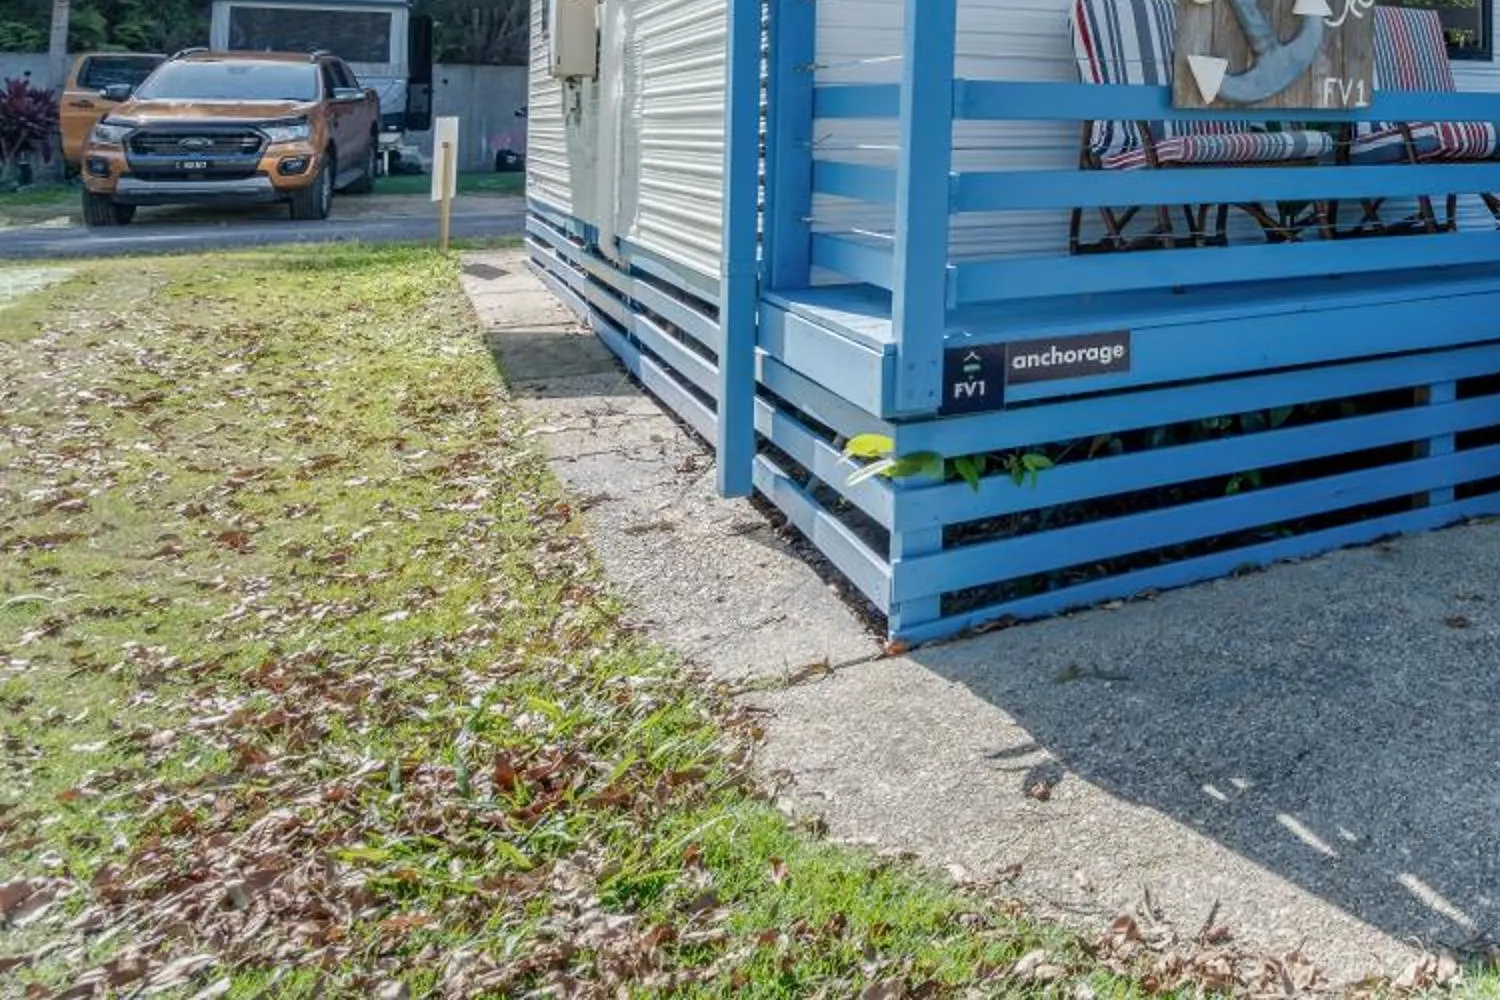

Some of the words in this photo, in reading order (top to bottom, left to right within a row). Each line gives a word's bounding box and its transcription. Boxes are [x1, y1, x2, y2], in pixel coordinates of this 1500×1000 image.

[1321, 77, 1369, 107] FV1
[1012, 344, 1125, 370] anchorage
[954, 380, 985, 398] FV1
